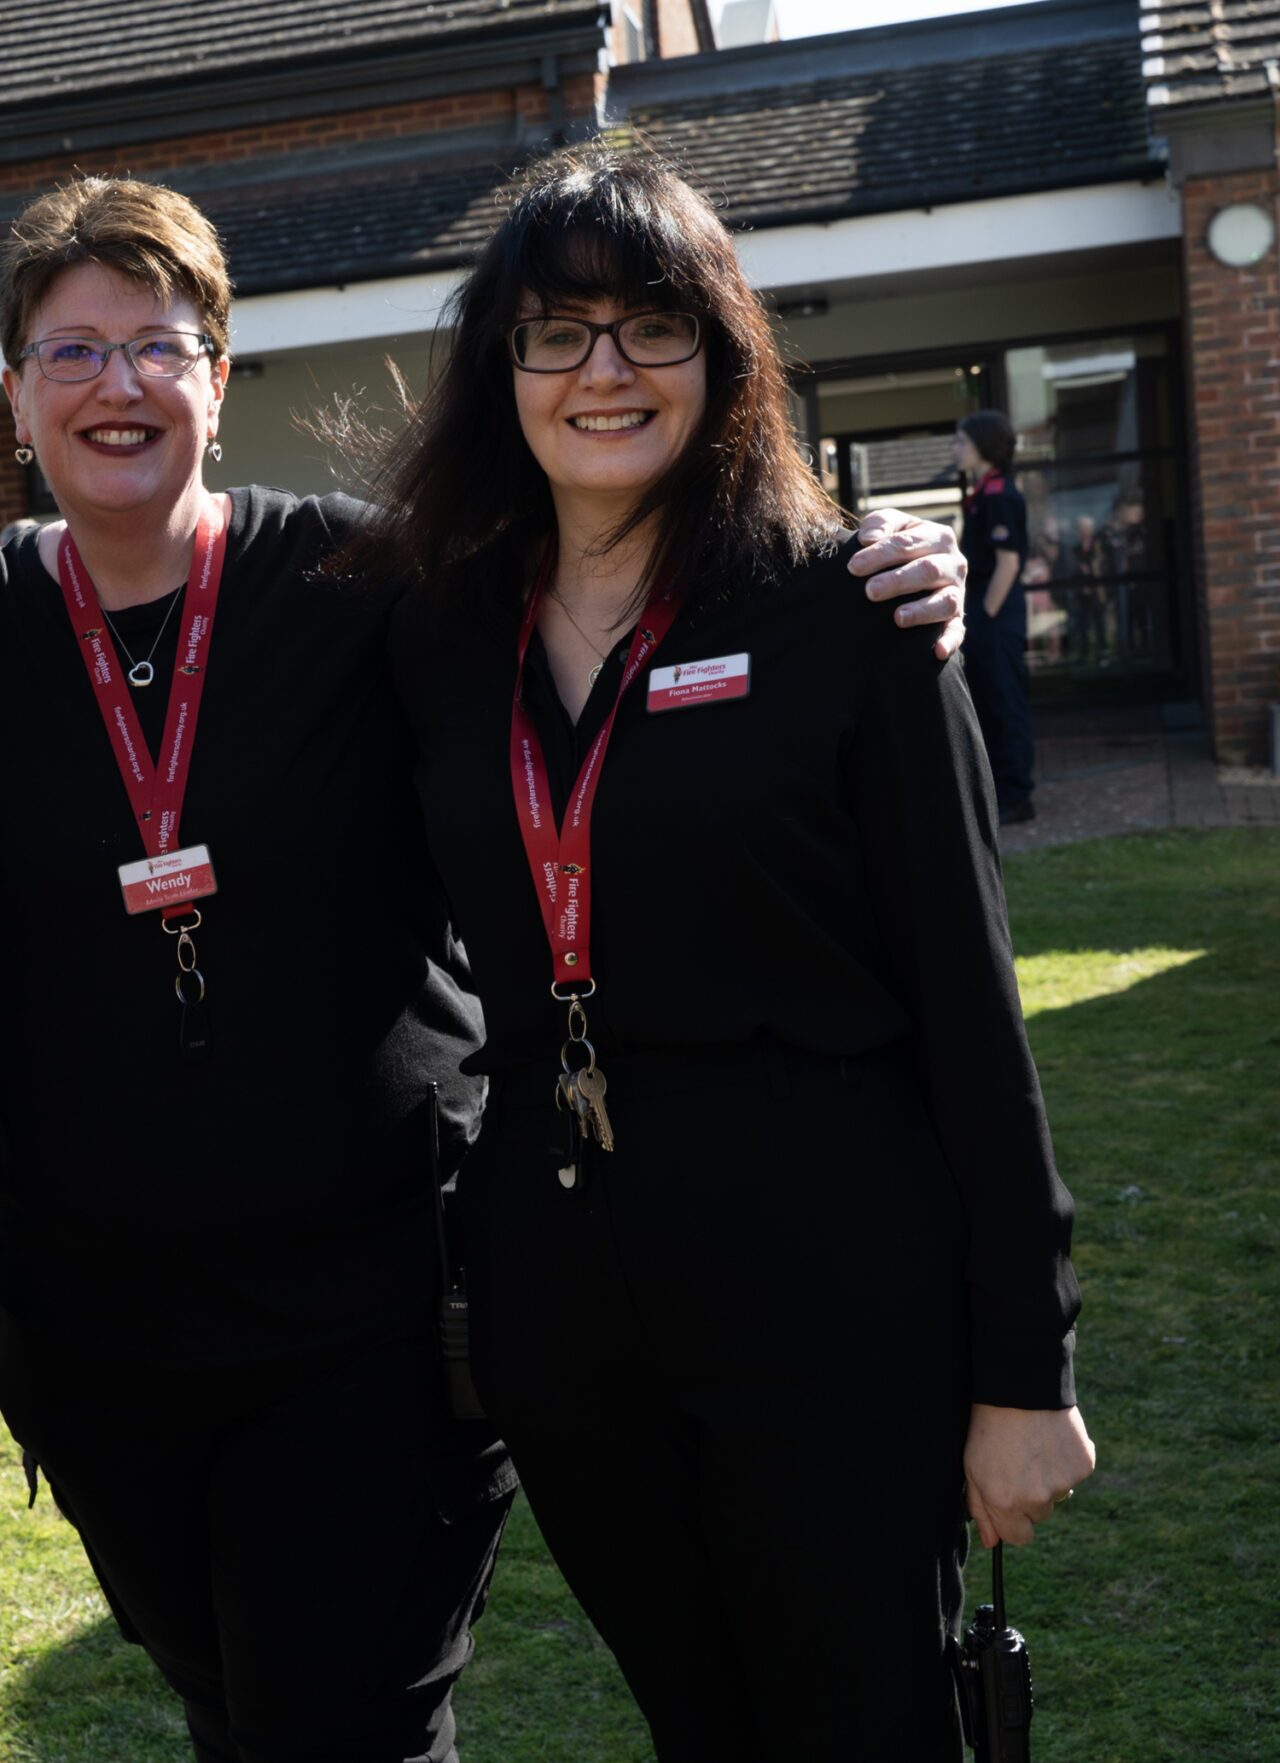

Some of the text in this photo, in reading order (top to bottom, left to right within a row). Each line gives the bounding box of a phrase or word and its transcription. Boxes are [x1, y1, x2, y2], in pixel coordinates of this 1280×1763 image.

[91, 638, 112, 683] Fire Fighters
[185, 615, 202, 664] Fire Fighters
[669, 681, 727, 697] Fiona Mattocks
[114, 706, 144, 782] firefighterscharity.org.uk
[167, 702, 188, 783] firefighterscharity.org.uk
[522, 739, 541, 829] firefighterscharity.org.uk
[158, 811, 170, 848] Fighters
[145, 872, 191, 894] Wendy
[565, 878, 580, 941] Fire Fighters
